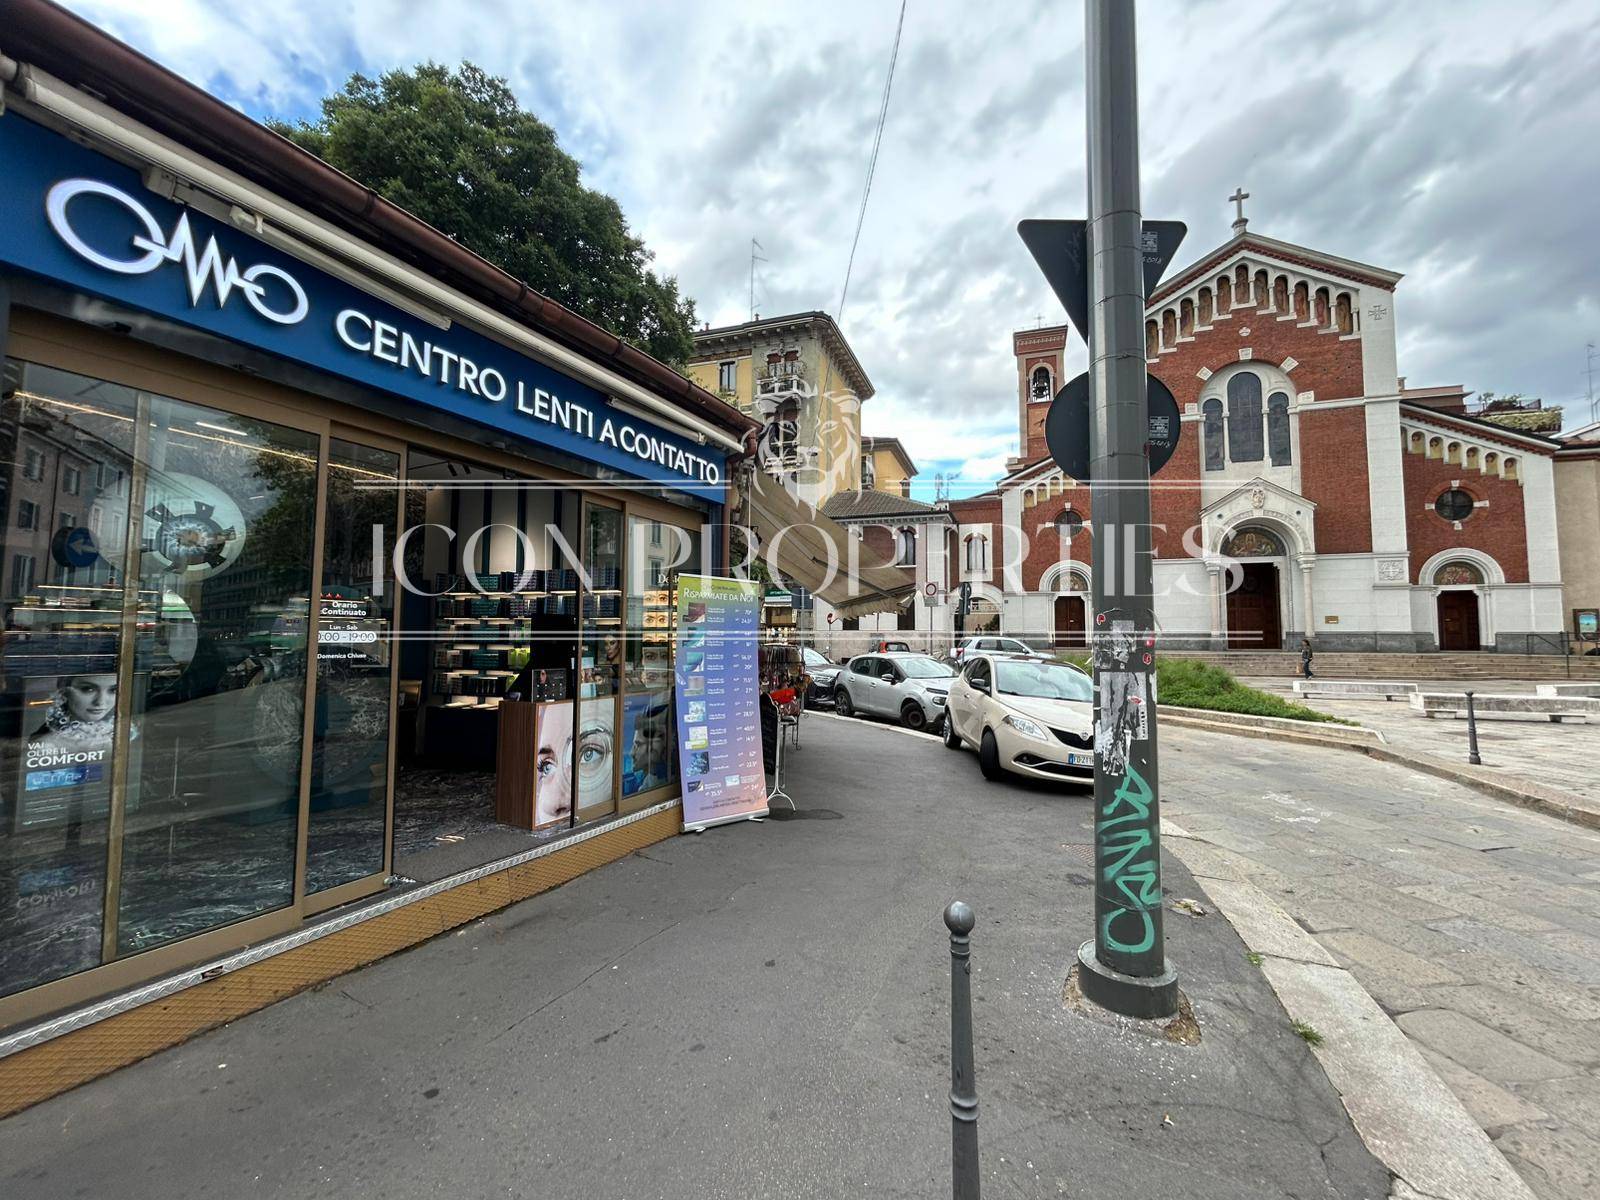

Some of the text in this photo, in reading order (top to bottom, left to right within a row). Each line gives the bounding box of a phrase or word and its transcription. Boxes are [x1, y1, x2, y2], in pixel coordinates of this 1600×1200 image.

[335, 308, 720, 486] CENTRO LENTI A CONTATTO
[683, 587, 728, 601] RISPARMIATE
[332, 600, 358, 609] Orario
[321, 608, 367, 617] Continuato
[318, 632, 340, 641] 0:00
[348, 632, 375, 642] 19:00
[28, 742, 45, 750] VAI
[26, 748, 58, 758] OLTRE
[26, 750, 106, 768] COMFORT
